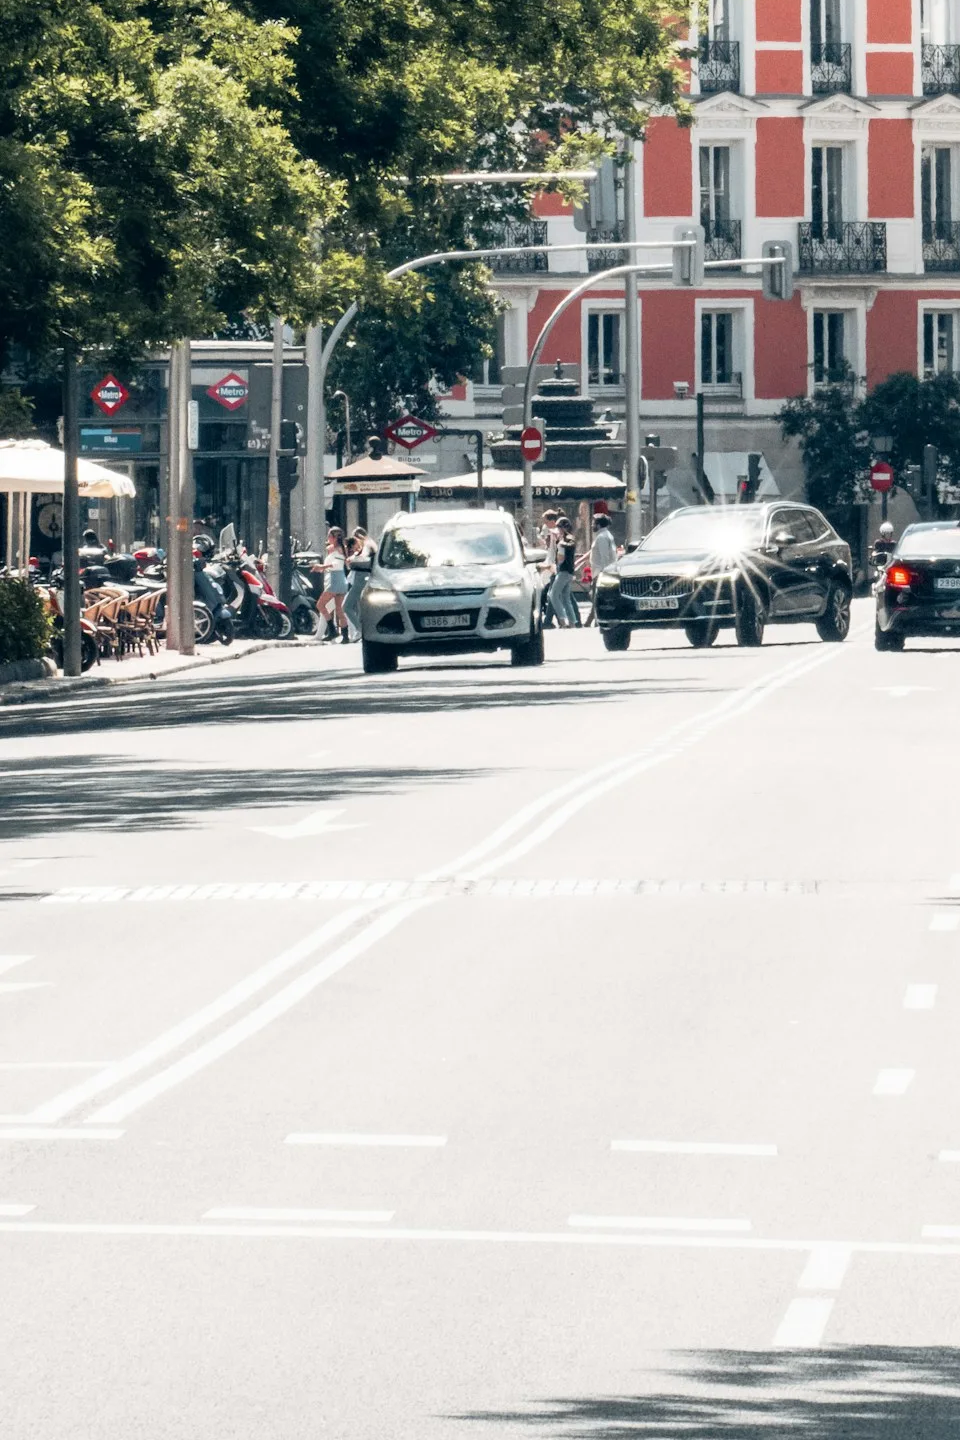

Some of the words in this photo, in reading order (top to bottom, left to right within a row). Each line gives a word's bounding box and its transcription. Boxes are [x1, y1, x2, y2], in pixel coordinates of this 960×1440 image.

[101, 389, 119, 400] Metro
[220, 387, 245, 397] Metro
[397, 428, 422, 436] Metro
